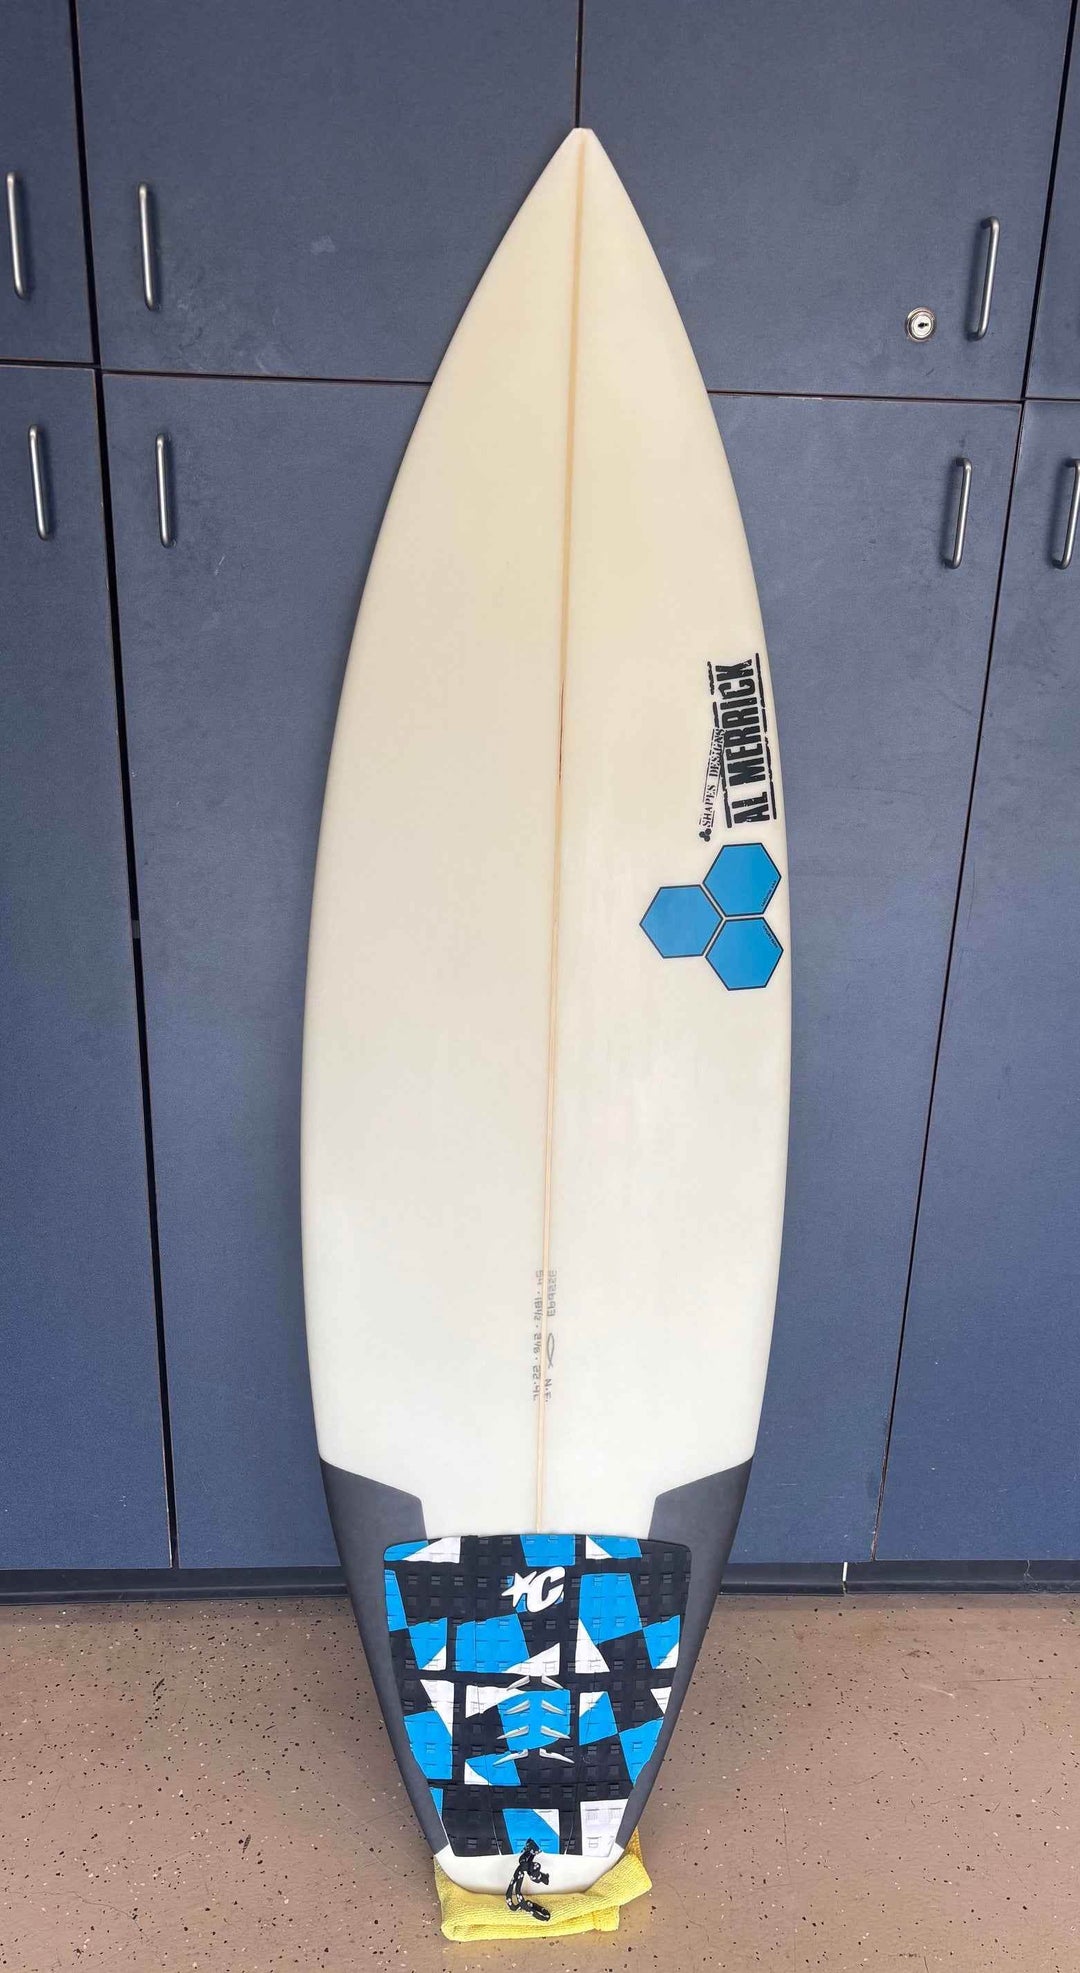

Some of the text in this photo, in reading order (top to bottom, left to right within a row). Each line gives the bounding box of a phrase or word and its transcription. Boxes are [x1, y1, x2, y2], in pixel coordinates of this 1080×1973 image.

[702, 728, 725, 828] SHAPES DESIGNS
[715, 659, 771, 824] AL MERRICK
